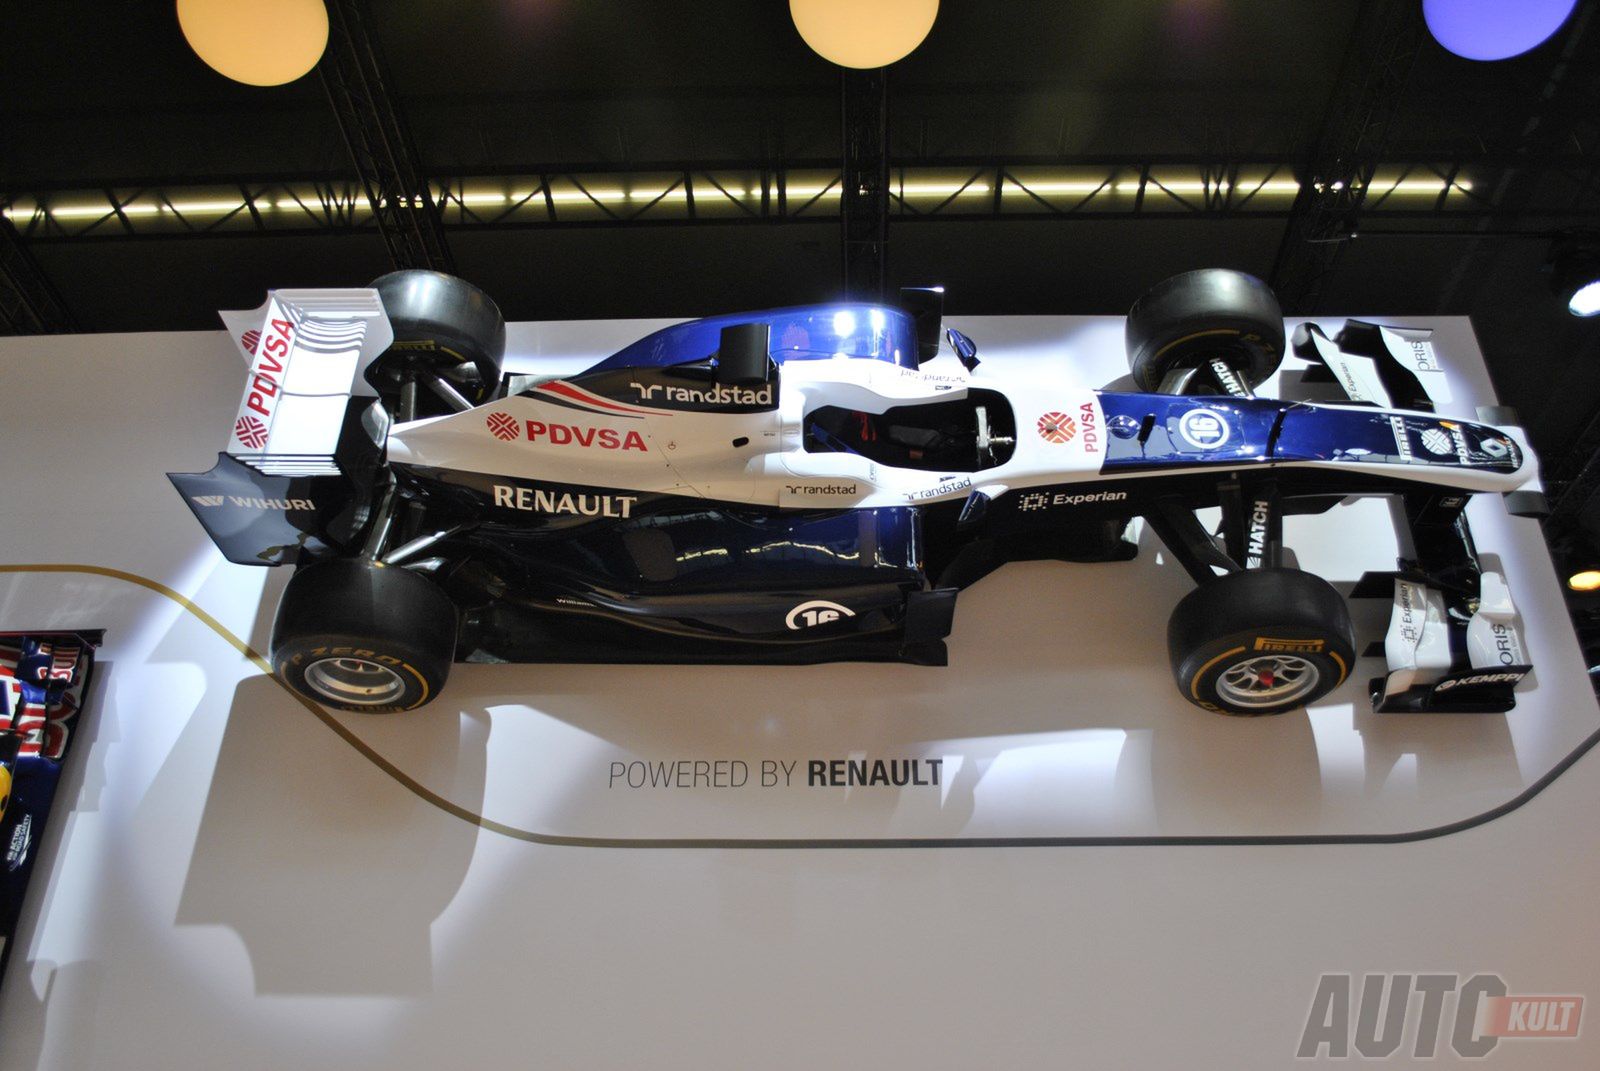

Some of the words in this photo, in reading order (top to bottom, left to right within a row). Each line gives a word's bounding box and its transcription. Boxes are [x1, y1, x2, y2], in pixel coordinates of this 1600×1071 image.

[247, 319, 294, 416] PDVSA
[667, 383, 772, 405] randstad
[526, 420, 648, 452] PDVSA
[1079, 402, 1099, 452] PDVSA
[1189, 417, 1220, 440] 16
[1390, 416, 1412, 461] PIRELLI
[1451, 424, 1471, 464] PDVSA
[493, 485, 637, 518] RENAULT
[803, 483, 857, 495] randstad
[919, 477, 972, 499] randstad
[1053, 490, 1127, 506] Experian
[227, 496, 316, 511] WIHURI
[1249, 500, 1268, 555] HATCH
[1402, 582, 1413, 624] Experian
[1254, 637, 1325, 653] PIRELLI
[1494, 623, 1513, 665] ORIS
[1456, 673, 1525, 686] KEMPPI
[609, 760, 748, 788] POWERED
[761, 760, 797, 787] BY
[808, 759, 943, 787] RENAULT
[10, 823, 22, 850] ACTION
